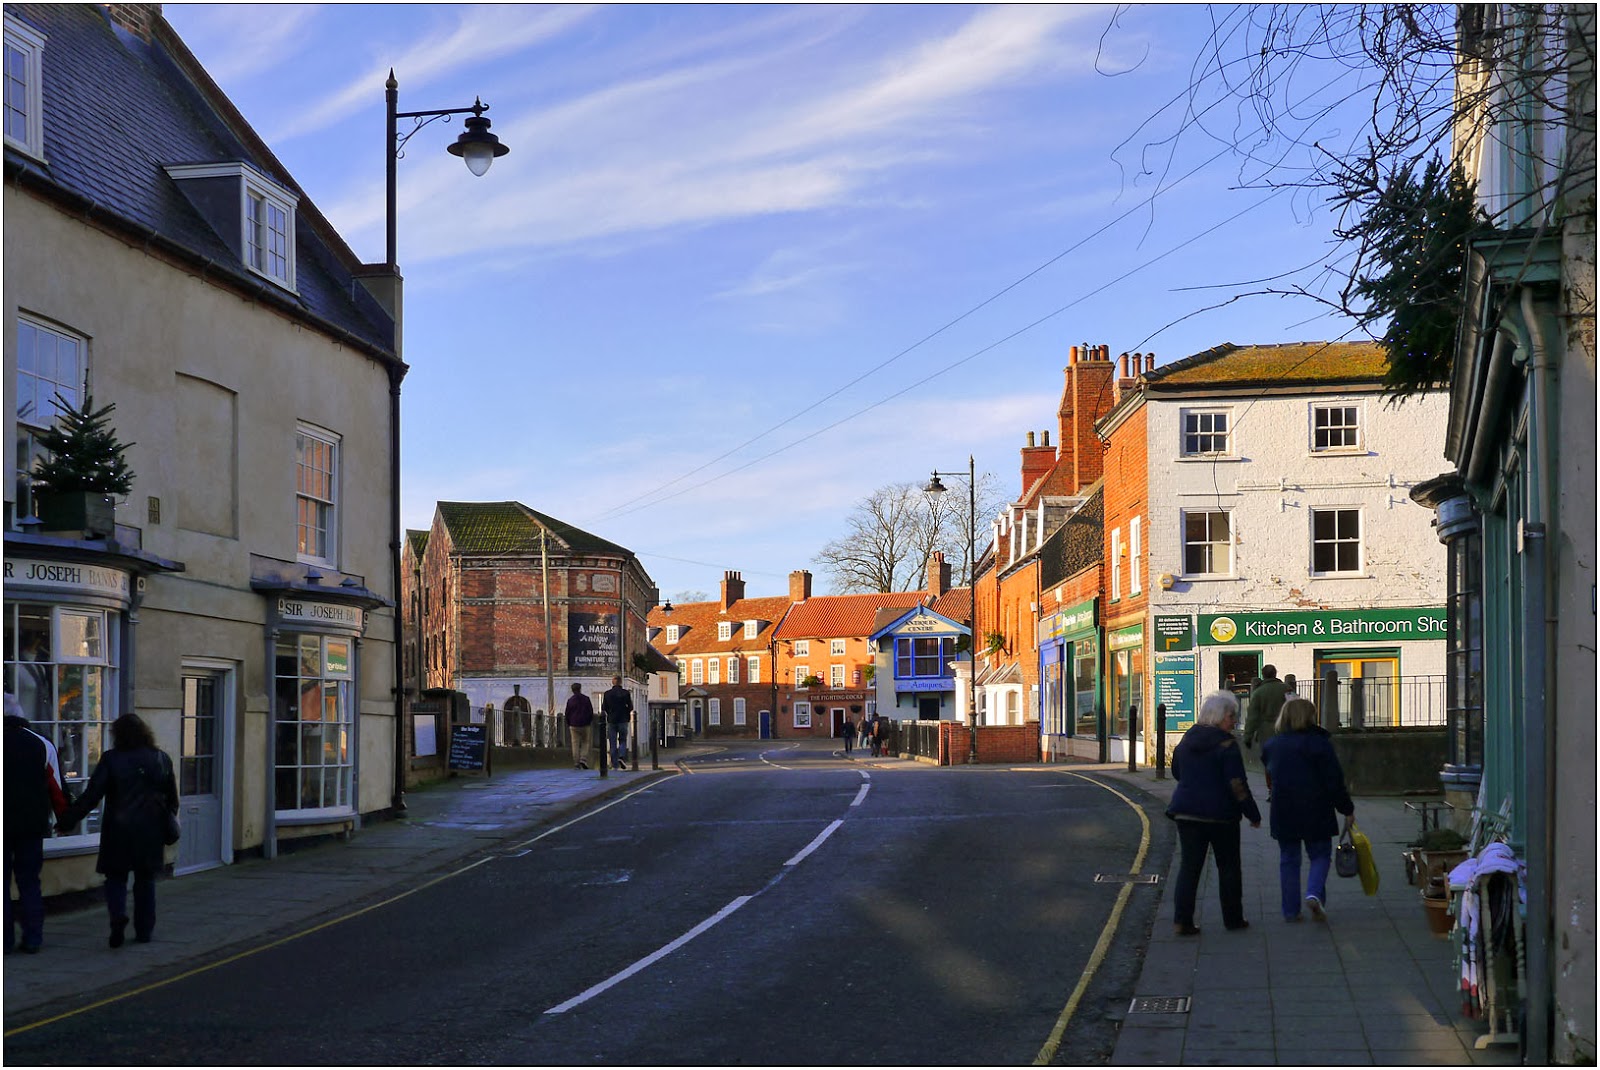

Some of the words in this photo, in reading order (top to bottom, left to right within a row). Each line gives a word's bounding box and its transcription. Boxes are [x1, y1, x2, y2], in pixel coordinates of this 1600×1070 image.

[26, 563, 81, 584] JOSEPH
[285, 603, 303, 616] SIR
[310, 605, 343, 620] JOSEPH
[1245, 621, 1307, 636] Kitchen
[1312, 620, 1326, 635] &
[1330, 618, 1412, 634] Bathroom
[1417, 617, 1447, 631] Sho
[911, 681, 943, 690] Antiques
